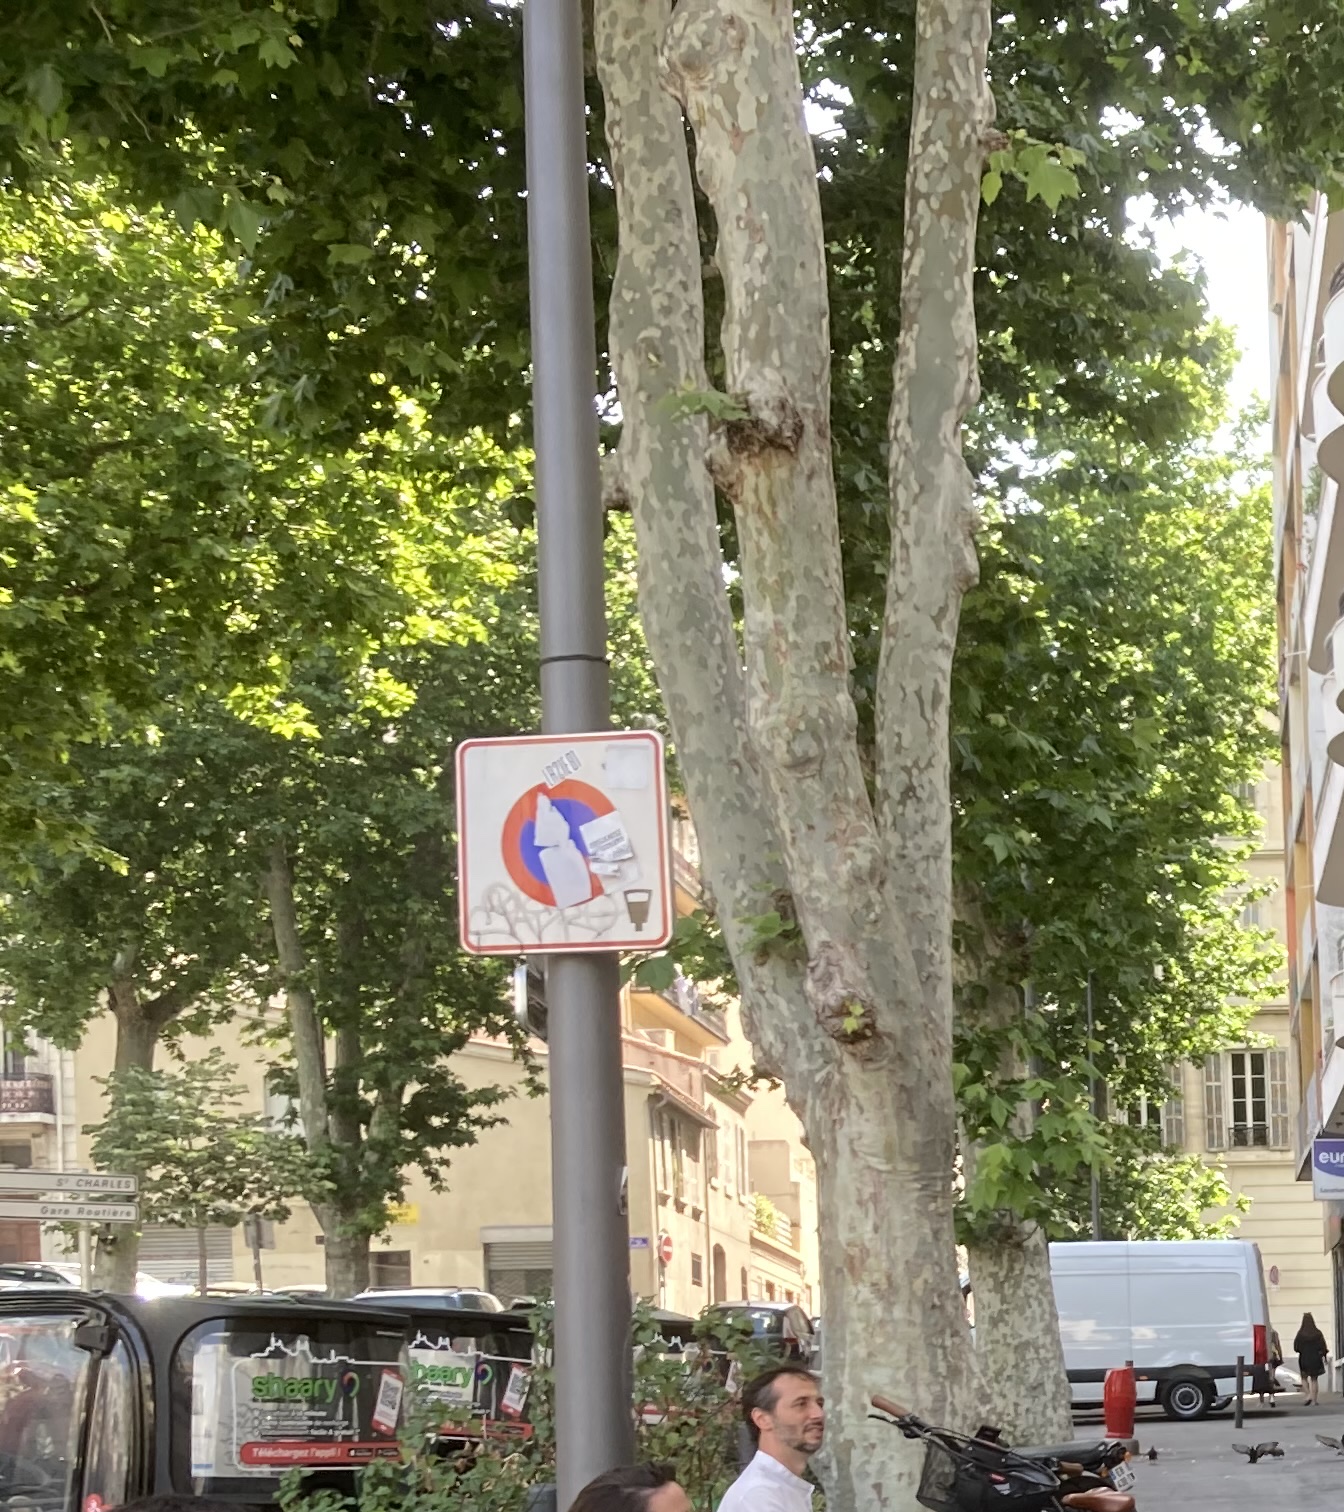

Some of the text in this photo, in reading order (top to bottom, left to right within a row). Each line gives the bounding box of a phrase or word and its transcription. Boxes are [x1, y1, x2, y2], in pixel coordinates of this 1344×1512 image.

[76, 1178, 131, 1189] CHARLES
[40, 1206, 132, 1217] Gare Routière
[252, 1372, 337, 1403] shaary
